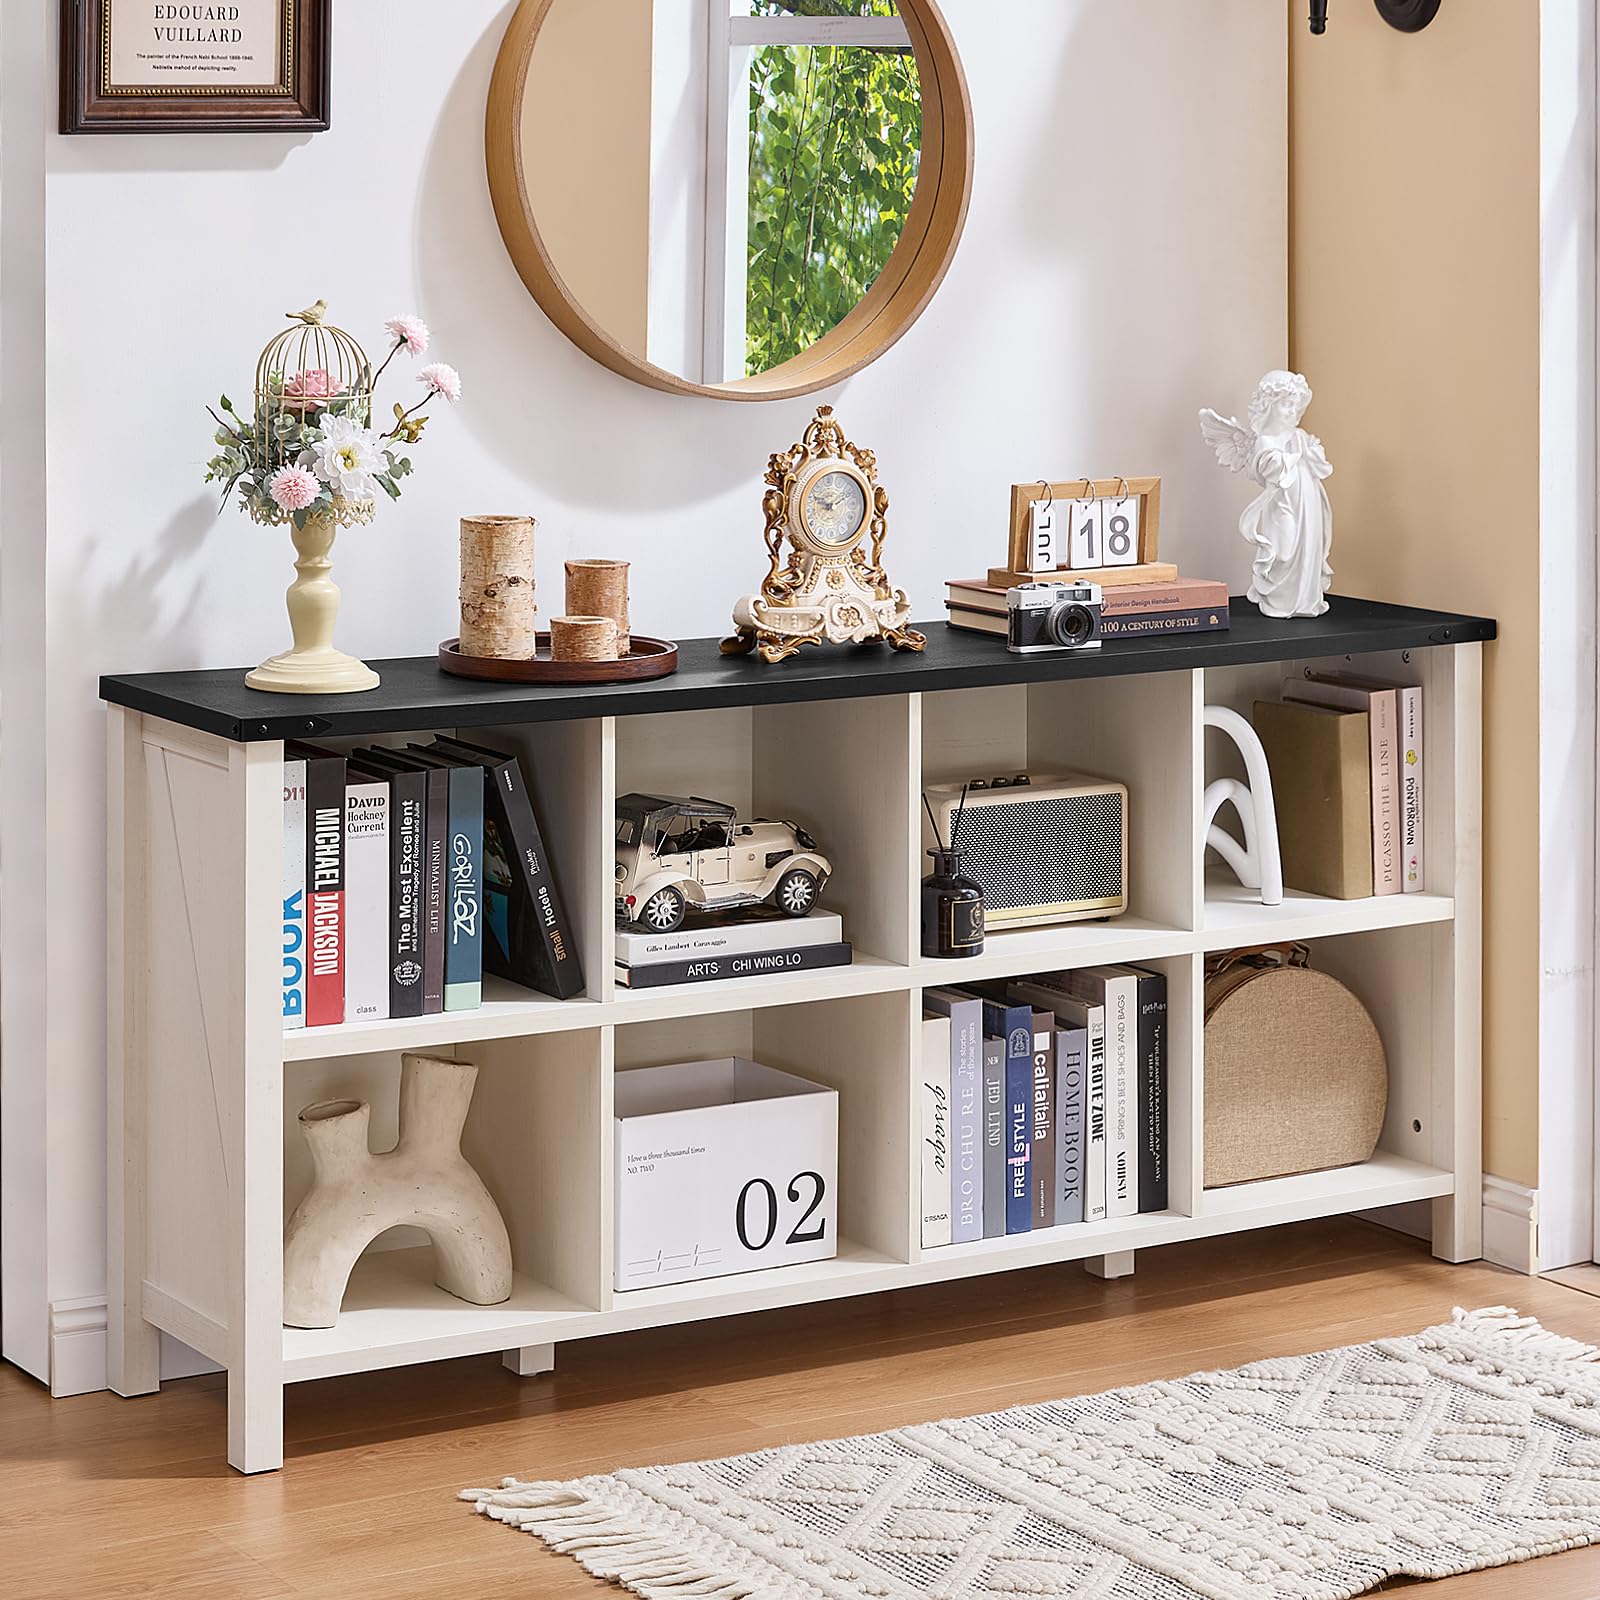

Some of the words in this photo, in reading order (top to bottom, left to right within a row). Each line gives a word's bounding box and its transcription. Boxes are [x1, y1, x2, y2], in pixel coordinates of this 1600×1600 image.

[154, 5, 239, 21] EDOUARD
[153, 27, 242, 43] VUILLARD
[1038, 516, 1051, 563] JUL
[1110, 601, 1130, 609] Interior
[1131, 600, 1151, 608] Design
[1152, 597, 1180, 606] Handbook
[1121, 623, 1127, 632] A
[1127, 620, 1166, 631] CENTURY
[1165, 619, 1177, 628] OF
[1176, 617, 1200, 628] STYLE
[1380, 739, 1389, 777] LINE
[348, 796, 385, 809] DAVID
[1382, 784, 1390, 816] THE
[1405, 777, 1415, 845] PONYBROWN
[347, 811, 385, 822] Hockney
[347, 822, 385, 833] Current
[314, 807, 340, 890] MICHAEL
[399, 799, 414, 875] Excellent
[1383, 821, 1392, 882] PICASSO
[412, 868, 420, 896] Tragedy
[431, 840, 440, 906] MINIMALIST
[399, 878, 412, 919] Most
[538, 886, 556, 927] Hotels
[313, 892, 339, 976] JACKSON
[430, 909, 439, 934] LIFE
[398, 922, 411, 954] The
[549, 929, 567, 961] small
[646, 944, 663, 953] Gilles
[664, 942, 690, 951] Lambert
[693, 938, 727, 948] Caravaggio
[732, 959, 751, 972] CHI
[753, 955, 784, 970] WING
[786, 953, 802, 966] LO
[356, 1005, 377, 1014] class
[1117, 994, 1126, 1020] BAGS
[959, 1029, 967, 1057] stories
[968, 1022, 977, 1045] years
[1117, 1022, 1126, 1043] AND
[967, 1046, 975, 1069] those
[1091, 1036, 1104, 1062] DIE
[1117, 1044, 1126, 1075] SHOES
[958, 1058, 966, 1076] The
[966, 1071, 975, 1081] of
[986, 1078, 1000, 1104] JED
[1034, 1053, 1050, 1140] caliaitalia
[1065, 1051, 1081, 1126] HOME
[1091, 1063, 1104, 1102] ROTE
[1117, 1078, 1126, 1097] BEST
[988, 1111, 1000, 1147] LIND
[1013, 1102, 1025, 1153] STYLE
[1091, 1103, 1104, 1144] ZONE
[1117, 1099, 1126, 1141] SPRING'S
[1148, 1115, 1154, 1126] TO
[631, 1154, 642, 1162] love
[648, 1152, 663, 1160] three
[663, 1146, 690, 1158] thousand
[690, 1146, 706, 1154] times
[1155, 1136, 1161, 1151] AN
[640, 1164, 655, 1172] TWO
[1013, 1156, 1025, 1198] FREE
[1064, 1131, 1080, 1202] BOOK
[1116, 1151, 1127, 1199] FASHION
[736, 1171, 826, 1251] 02
